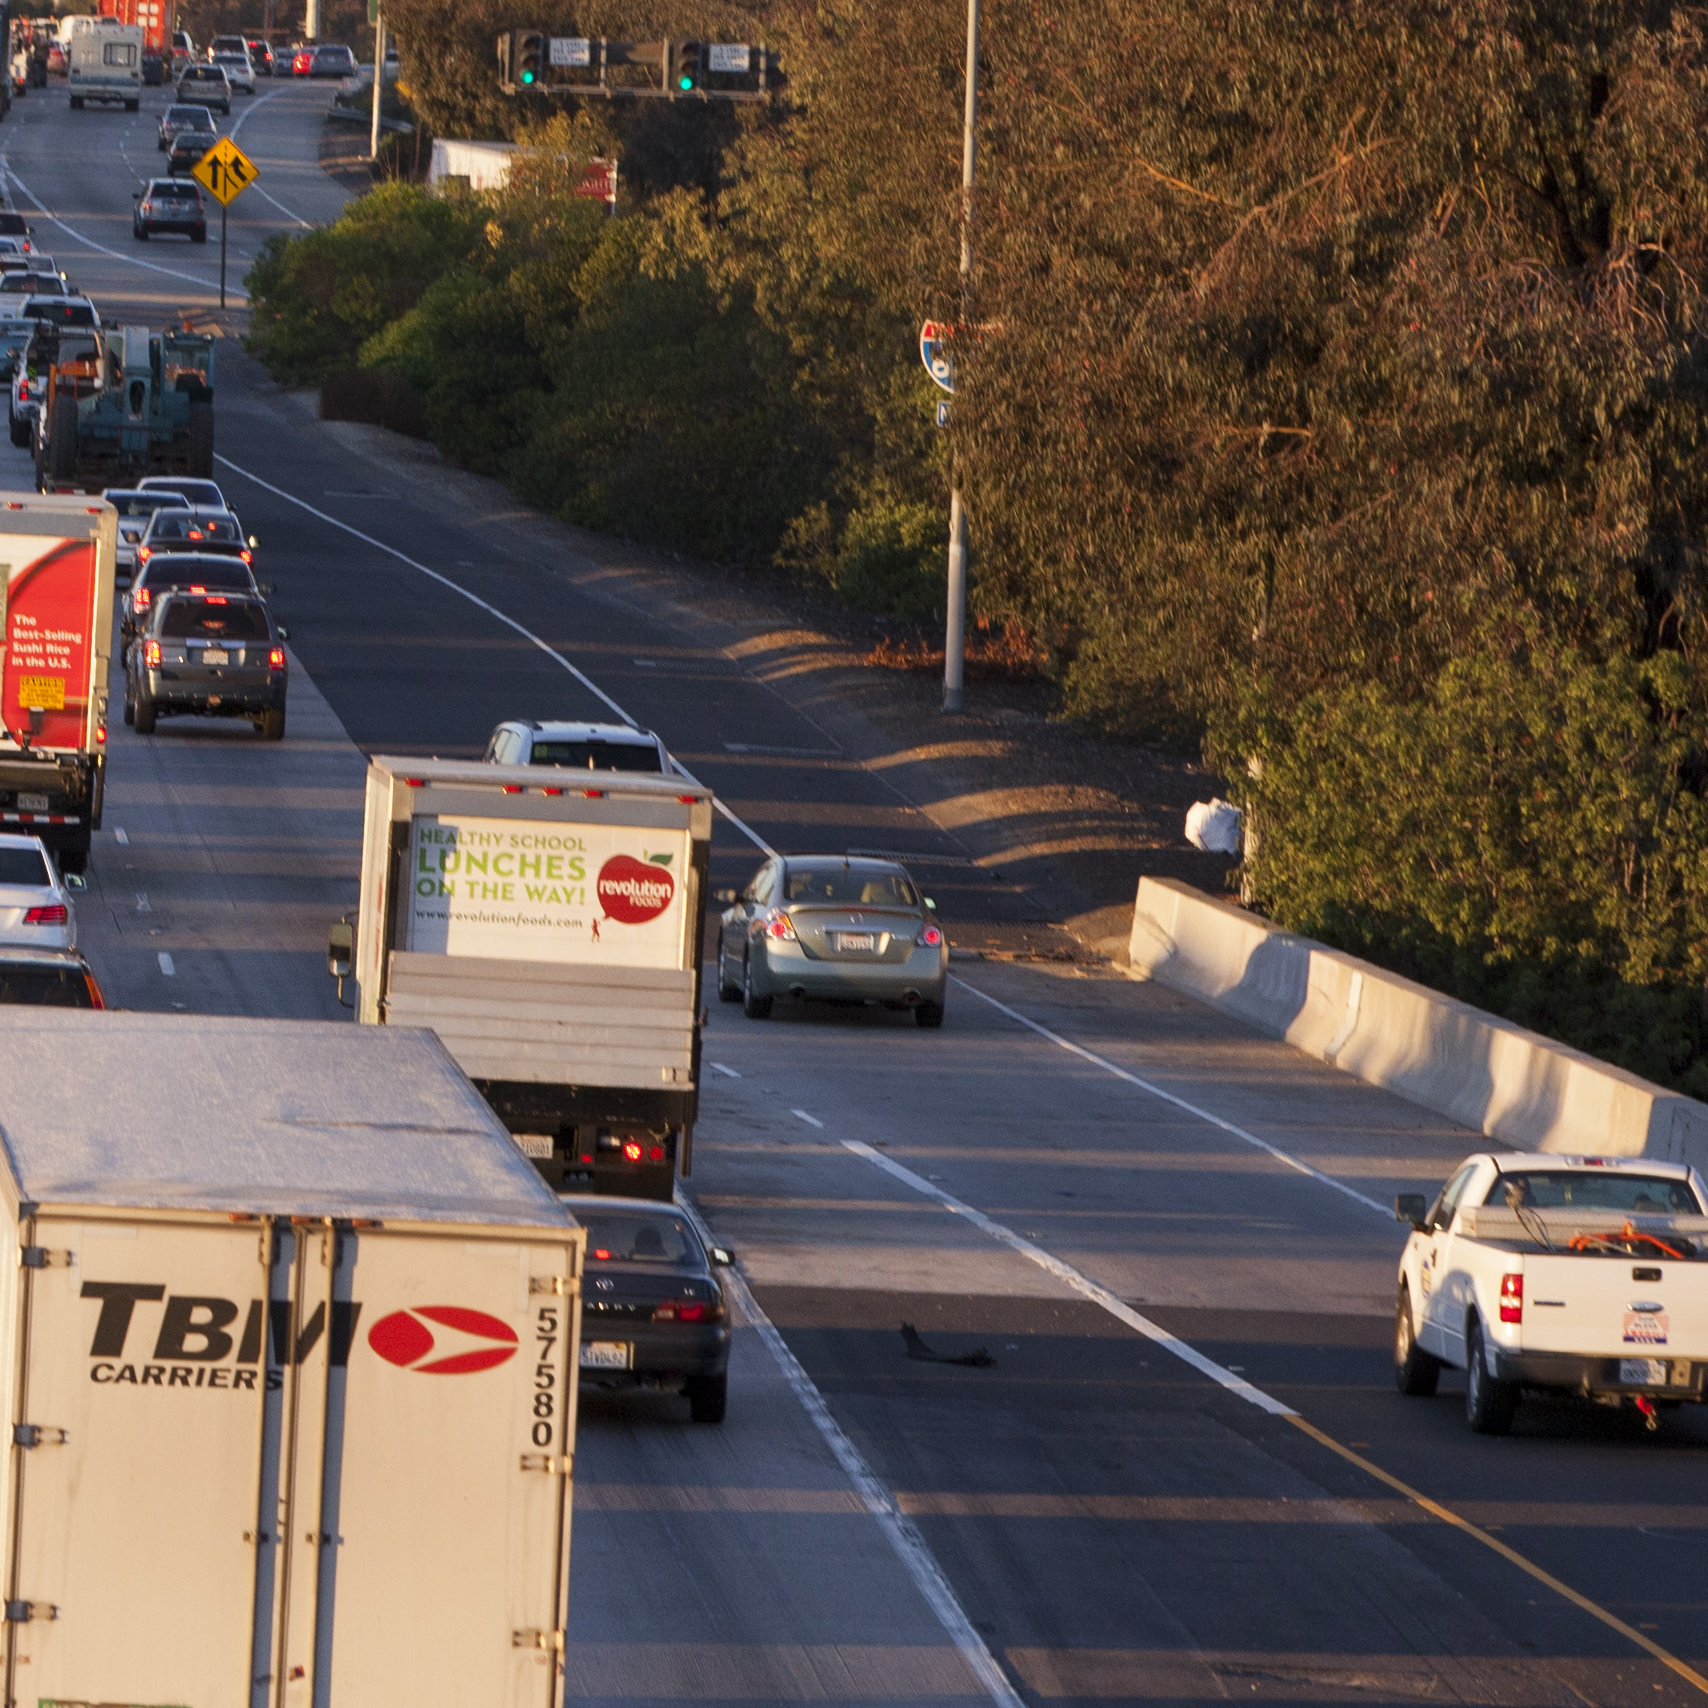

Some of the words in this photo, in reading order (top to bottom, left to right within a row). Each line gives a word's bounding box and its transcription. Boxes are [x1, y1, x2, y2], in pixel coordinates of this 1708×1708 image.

[13, 613, 37, 625] The
[13, 629, 82, 645] Best-Selling
[13, 641, 43, 654] Sushi
[46, 643, 70, 655] Rice
[12, 654, 23, 666] in
[26, 655, 45, 667] the
[48, 657, 71, 669] U.S.
[420, 829, 505, 848] HEALTHY
[510, 835, 587, 853] SCHOOL
[418, 848, 586, 882] LUNCHES
[415, 877, 455, 899] ON
[465, 881, 515, 901] THE
[525, 884, 585, 906] WAY!
[599, 878, 672, 899] revolution
[629, 895, 662, 908] FOODS
[416, 908, 583, 929] www.revolutionfoods.com
[80, 1281, 363, 1367] TBM
[90, 1363, 284, 1391] CARRIERS
[532, 1307, 558, 1447] 57580
